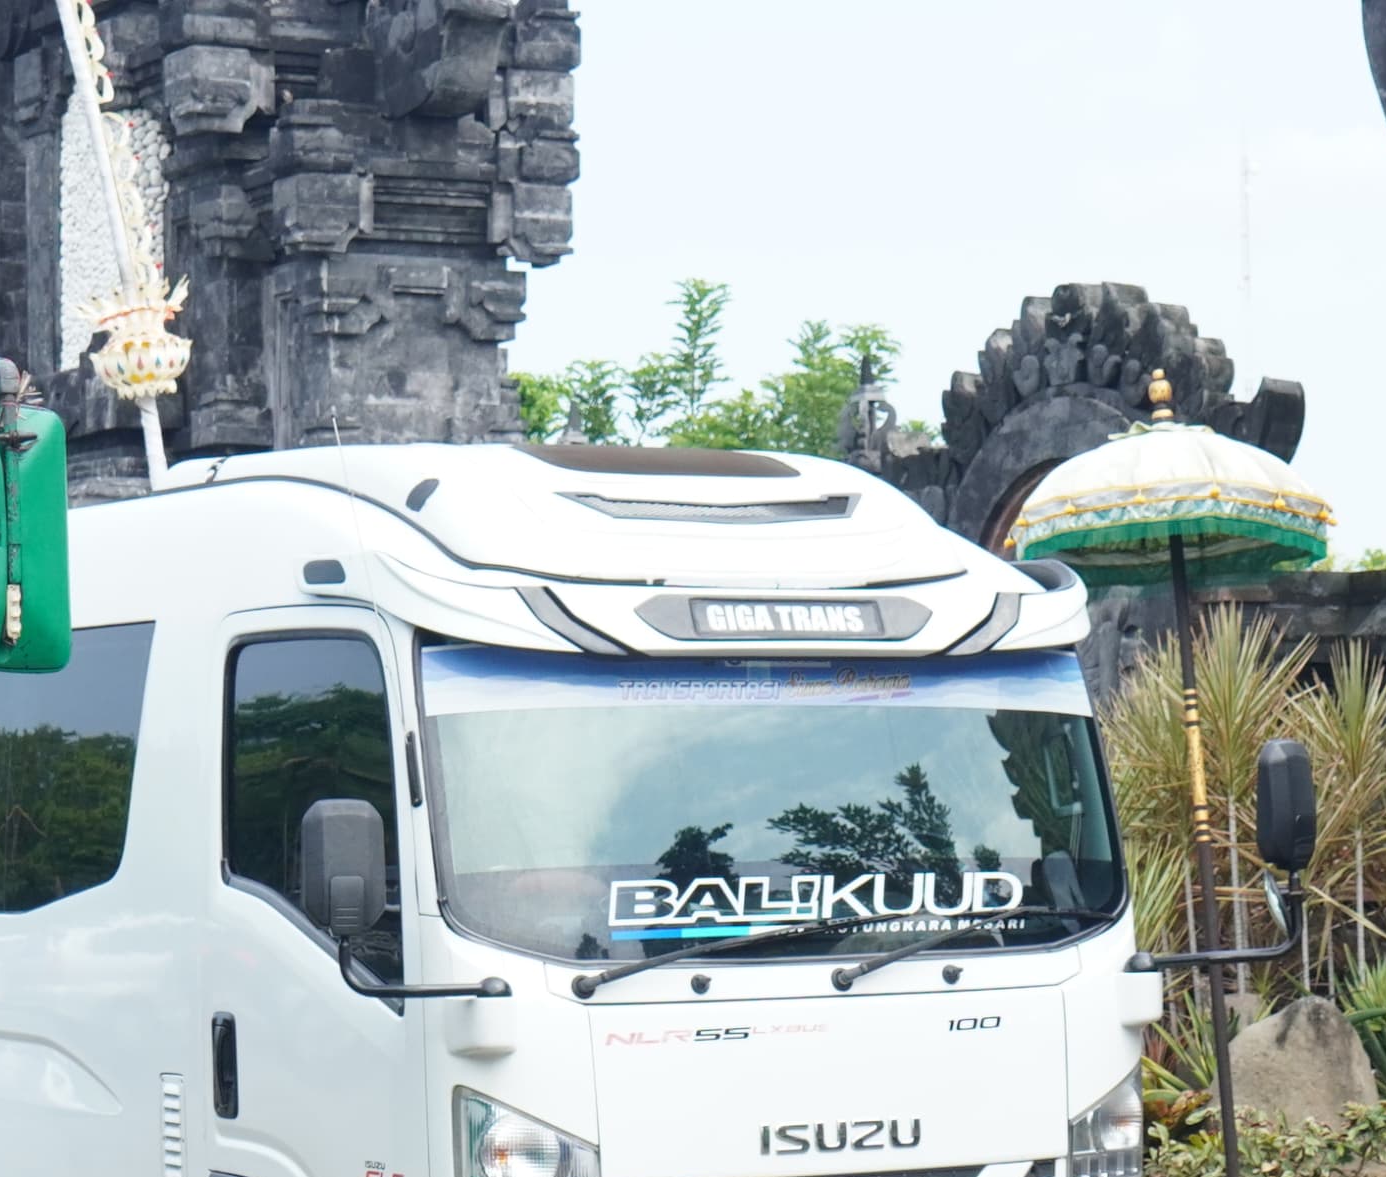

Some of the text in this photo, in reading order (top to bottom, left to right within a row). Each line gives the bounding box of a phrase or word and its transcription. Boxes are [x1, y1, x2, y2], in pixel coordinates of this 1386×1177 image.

[706, 604, 864, 633] GIGA TRANS
[618, 679, 780, 700] TRANSPORTASI
[947, 1015, 1002, 1032] 100
[760, 1118, 922, 1157] ISUZU
[364, 1160, 386, 1171] ISUZU
